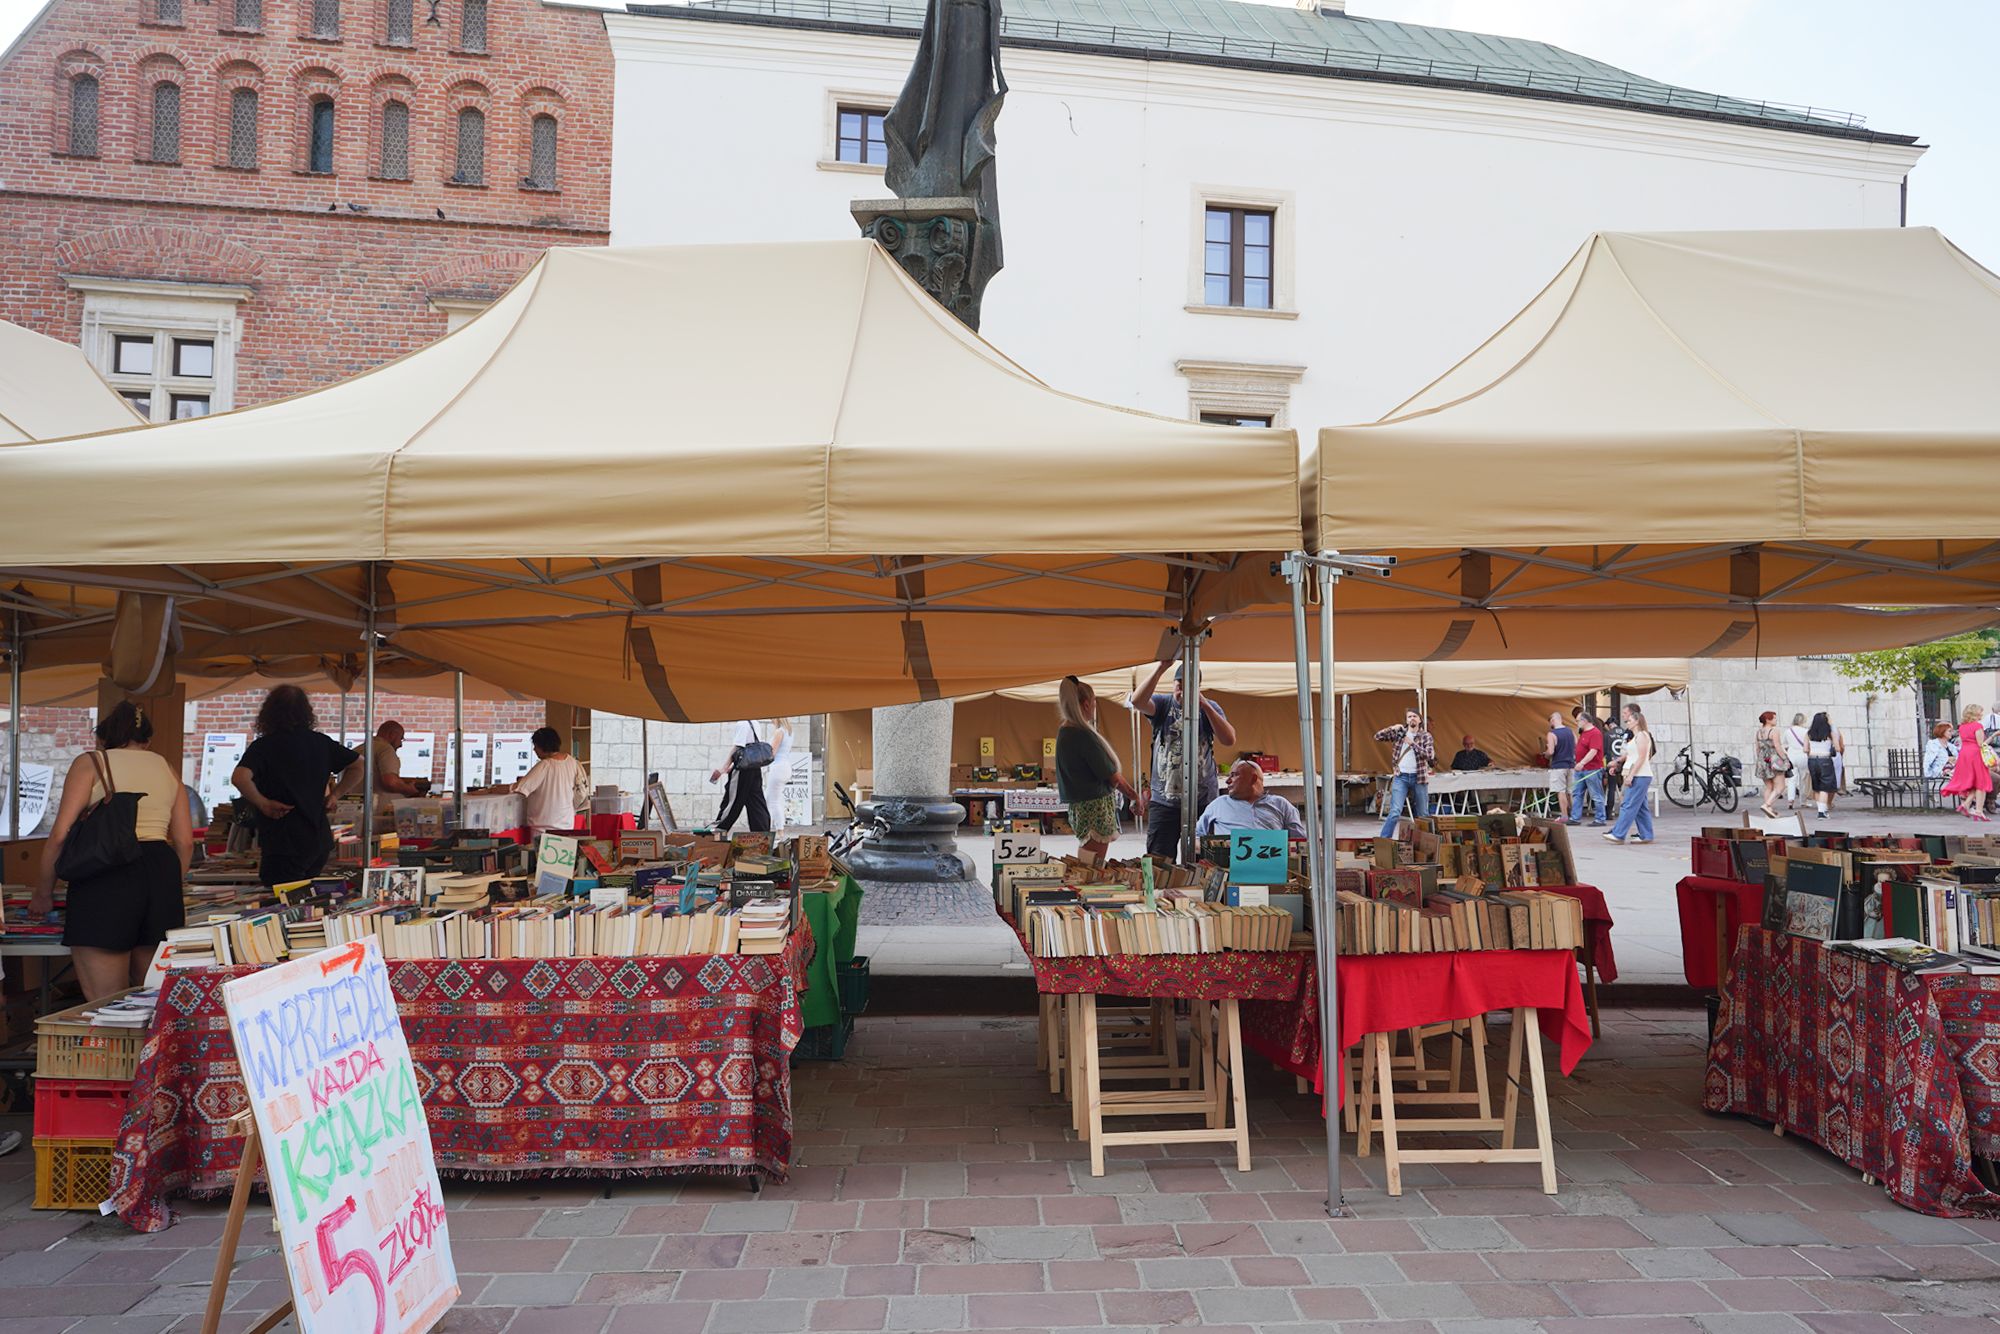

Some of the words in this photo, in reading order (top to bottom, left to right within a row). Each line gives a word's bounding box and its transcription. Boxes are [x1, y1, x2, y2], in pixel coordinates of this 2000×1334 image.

[982, 743, 990, 754] 5
[1044, 743, 1052, 754] 5
[998, 839, 1013, 859] 5
[1235, 836, 1254, 860] 5
[315, 1195, 386, 1334] 5
